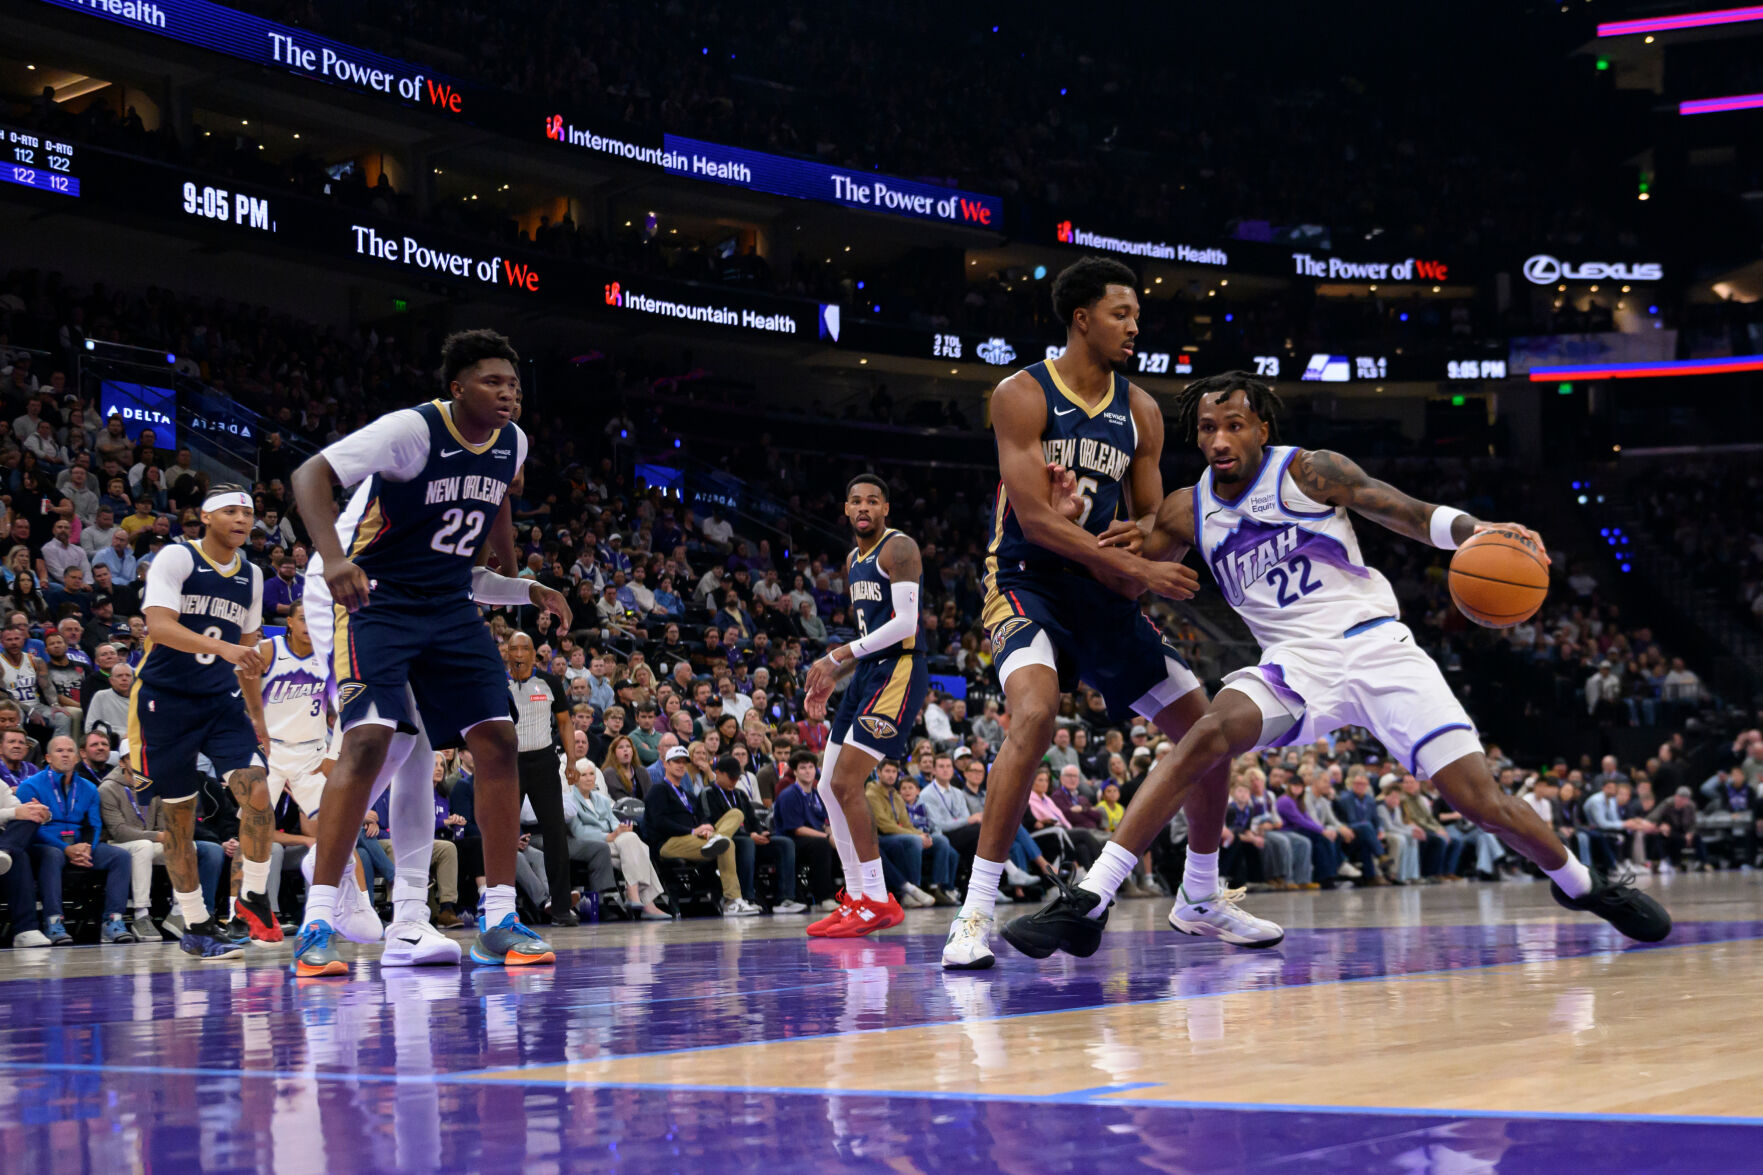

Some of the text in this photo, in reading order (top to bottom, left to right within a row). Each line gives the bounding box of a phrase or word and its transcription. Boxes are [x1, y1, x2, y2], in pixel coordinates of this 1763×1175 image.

[268, 32, 462, 113] The Power of We
[14, 147, 70, 172] 112 122
[45, 140, 73, 156] D-RTG
[568, 125, 688, 171] Intermountain
[693, 155, 751, 183] Health
[13, 167, 69, 192] 122 112
[183, 182, 268, 230] 9:05 PM
[831, 175, 991, 225] The Power of We
[352, 225, 540, 291] The Power of We
[1075, 229, 1175, 260] Intermountain
[1177, 244, 1228, 266] Health
[1292, 253, 1448, 281] The Power of We
[1562, 262, 1664, 280] LEXUS
[625, 290, 738, 326] Intermountain
[742, 309, 796, 333] Health
[1137, 352, 1170, 374] 7:27
[1253, 356, 1280, 377] 73
[1448, 360, 1506, 379] 9:05 PM
[123, 407, 171, 425] DELTA
[1042, 437, 1131, 482] NEW ORLEANS
[425, 476, 461, 505] NEW
[1250, 493, 1276, 506] Health
[1251, 502, 1276, 513] Equity
[430, 508, 485, 557] 22
[1215, 522, 1299, 607] UTAH
[1265, 554, 1324, 609] 22
[181, 594, 249, 628] NEW ORLEAN
[268, 680, 326, 704] UTAH
[310, 698, 322, 717] 3
